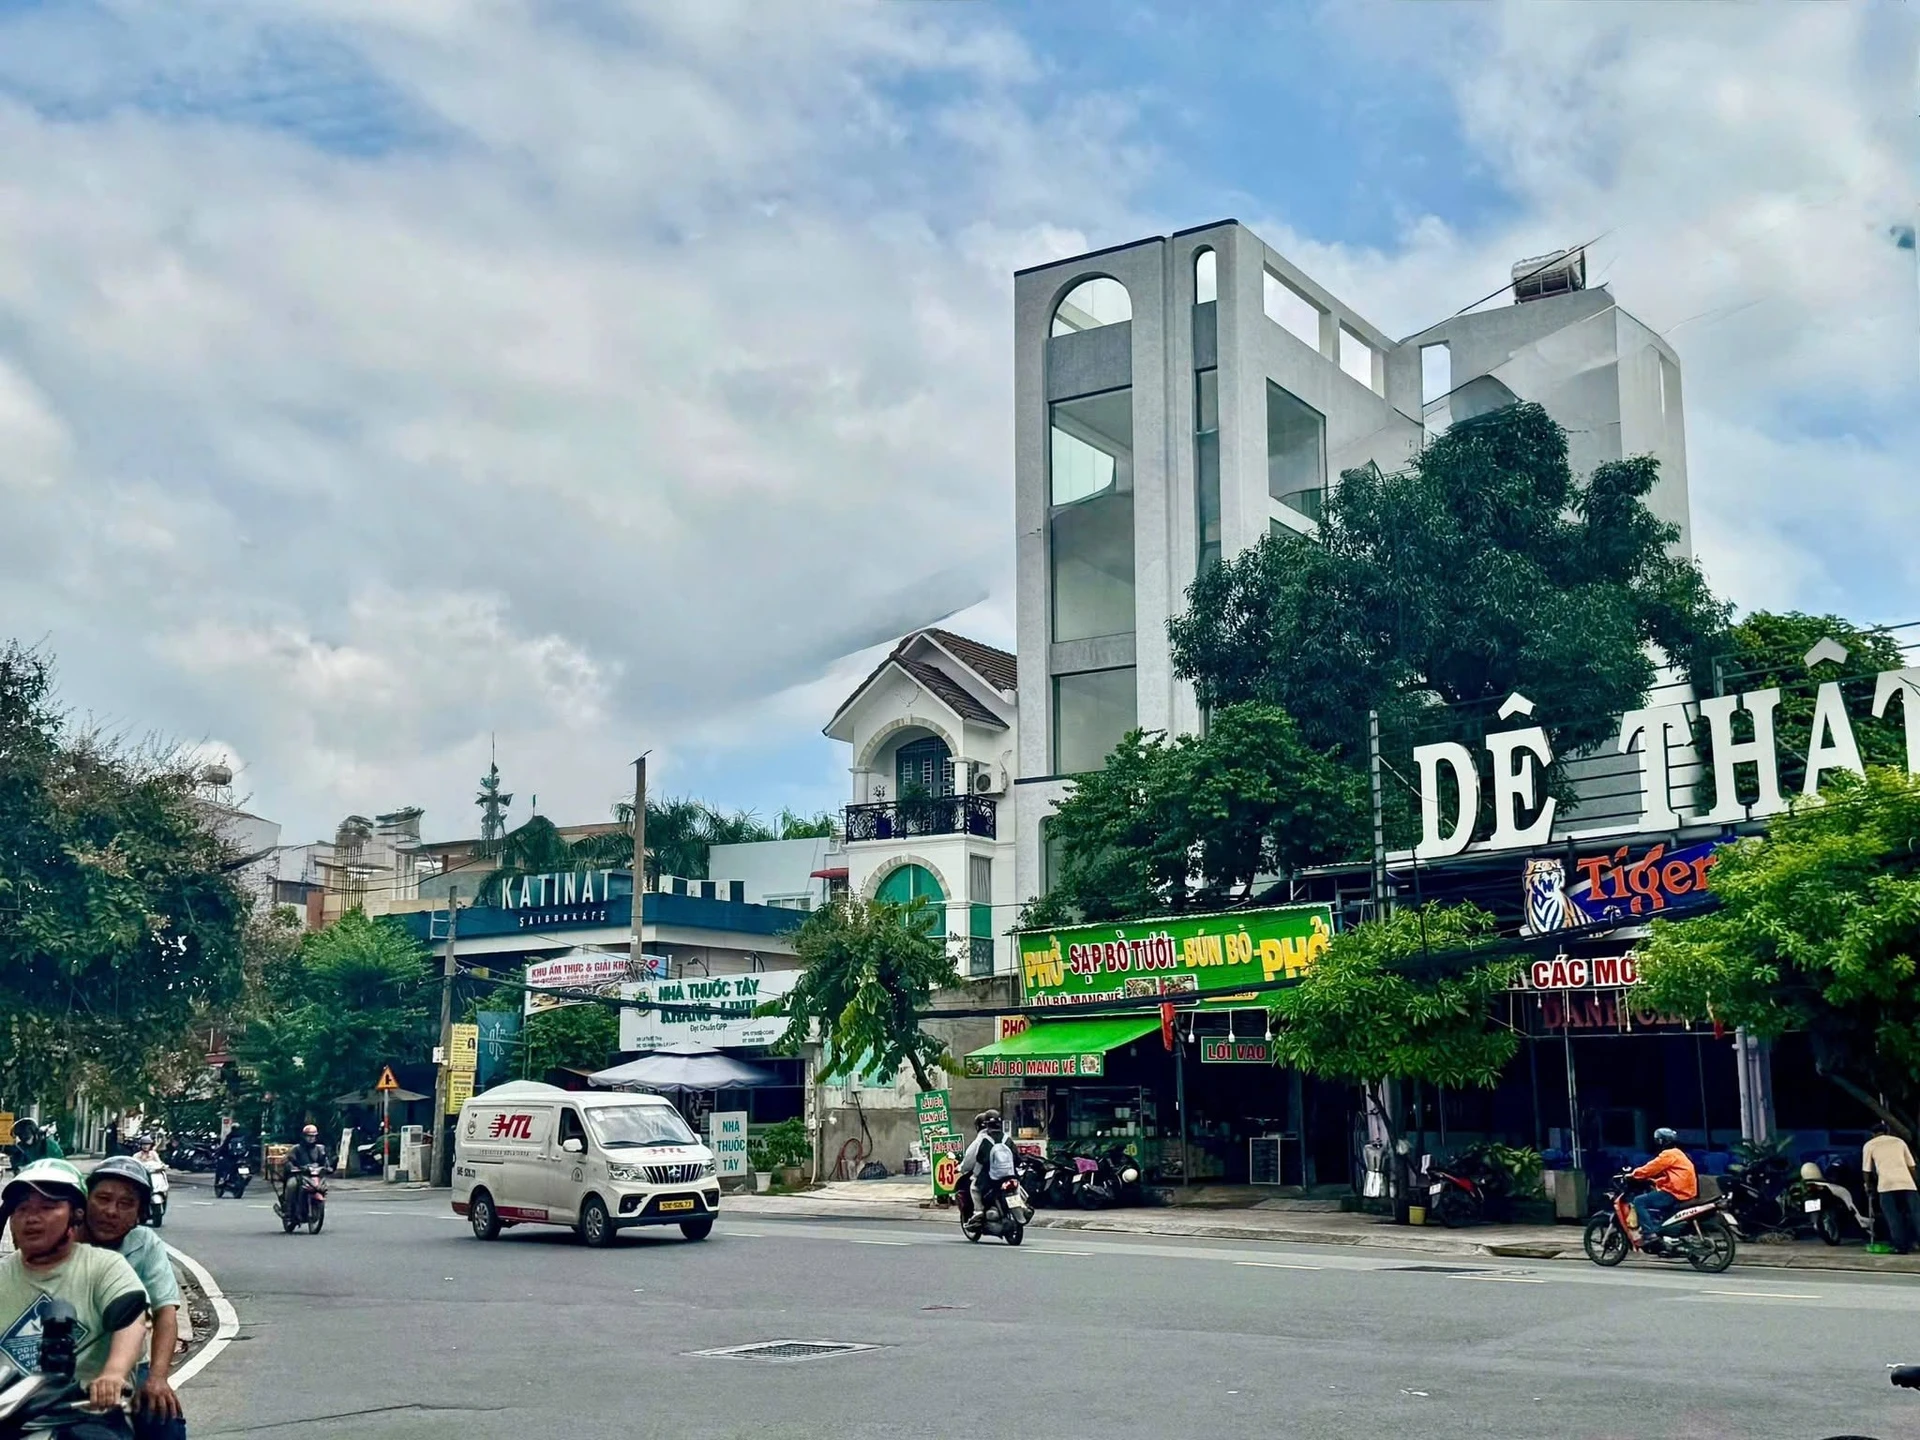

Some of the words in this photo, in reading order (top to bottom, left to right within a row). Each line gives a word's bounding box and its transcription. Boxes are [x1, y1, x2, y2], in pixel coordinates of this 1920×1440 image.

[1413, 692, 1557, 860] DÊ
[502, 868, 613, 910] KATINAT
[1576, 843, 1719, 914] Tiger
[1023, 934, 1065, 988] PHỞ
[1069, 943, 1103, 984] SẠP
[1104, 930, 1131, 973] BÒ
[1183, 928, 1224, 968] BÚN
[1224, 923, 1253, 965] BÒ
[532, 968, 547, 978] KHU
[1531, 954, 1588, 990] CÁC
[658, 981, 685, 1002] NHÀ
[688, 978, 731, 1000] THUỐC
[734, 976, 760, 997] TÂY
[1026, 1059, 1059, 1076] MANG
[722, 1116, 740, 1133] NHÀ
[716, 1134, 746, 1153] THUỐC
[722, 1156, 740, 1171] TÂY
